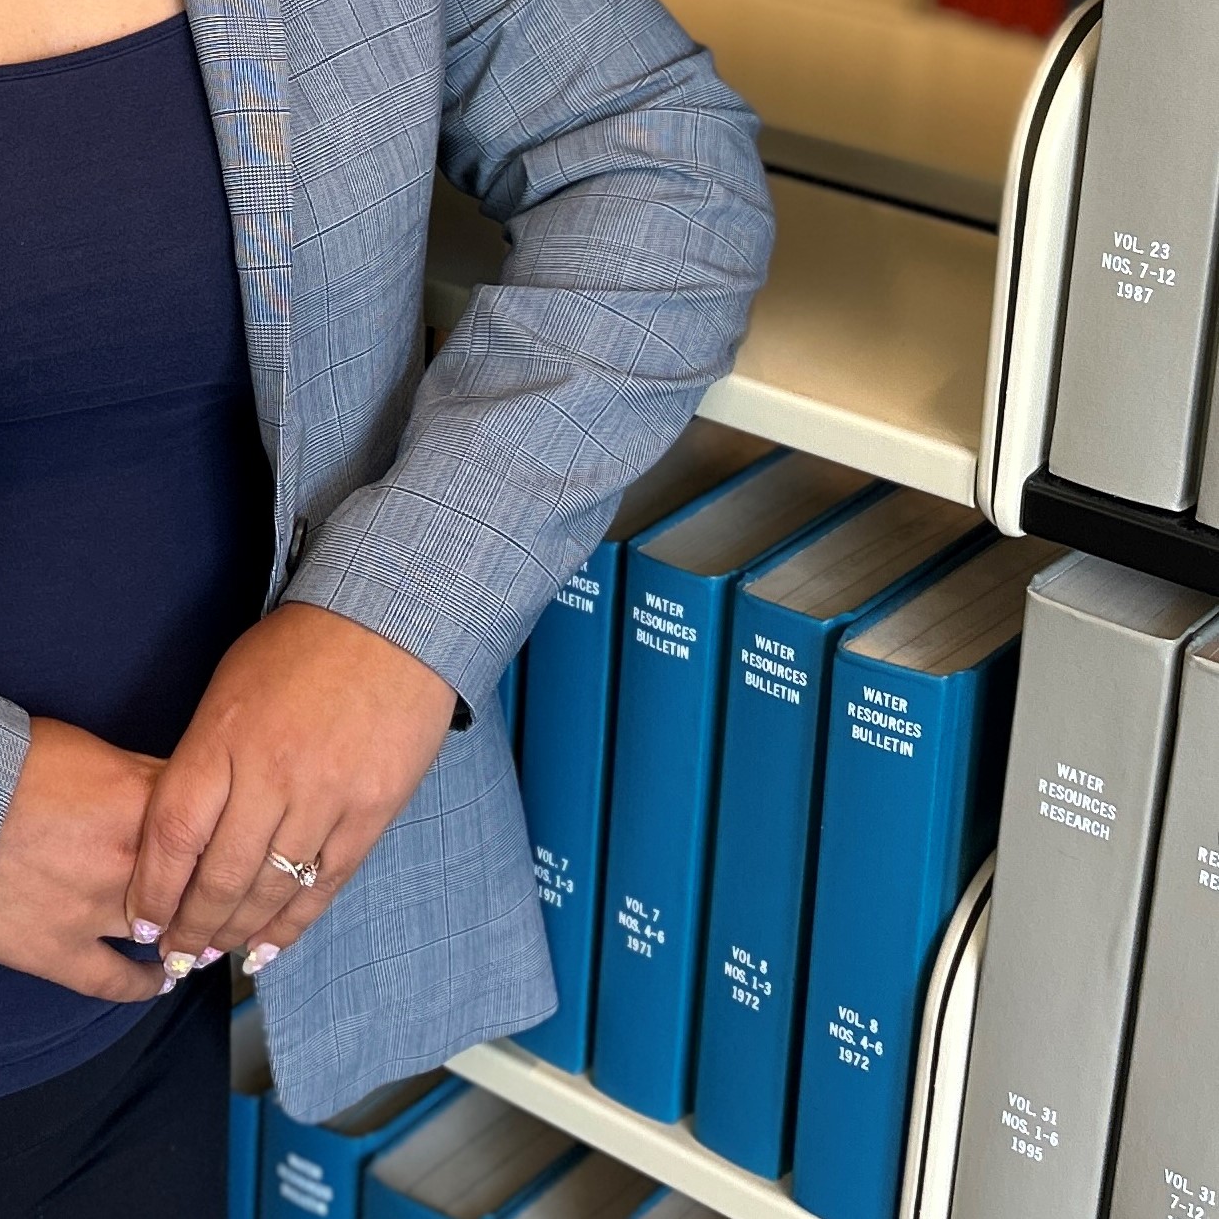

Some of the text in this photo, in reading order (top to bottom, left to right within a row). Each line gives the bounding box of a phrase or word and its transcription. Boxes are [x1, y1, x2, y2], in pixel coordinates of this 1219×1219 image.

[1150, 242, 1170, 260] 23
[1140, 263, 1176, 286] 7-12
[1117, 281, 1153, 303] 1987
[557, 592, 594, 614] LLETIN
[646, 592, 684, 618] WATER
[633, 607, 697, 642] RESOURCES
[636, 628, 689, 660] BULLETIN
[755, 633, 795, 661] WATER
[741, 649, 808, 687] RESOURCES
[745, 671, 800, 705] BULLETIN
[863, 685, 908, 714] WATER
[848, 702, 922, 739] RESOURCES
[852, 724, 914, 758] BULLETIN
[1057, 762, 1104, 793] WATER
[1038, 778, 1117, 821] RESOURCES
[1039, 801, 1110, 840] RESEARCH
[537, 846, 569, 871] VOL. 7
[538, 885, 562, 907] 1971
[556, 875, 574, 893] 1-3
[653, 908, 660, 922] 7
[627, 935, 652, 958] 1971
[644, 925, 664, 944] 4-6
[724, 962, 772, 996] NOS. 1-3
[760, 960, 768, 975] 8
[732, 985, 760, 1011] 1972
[830, 1022, 883, 1056] NOS. 4-6
[870, 1019, 878, 1034] 8
[838, 1046, 870, 1071] 1972
[1002, 1110, 1059, 1147] NOS. 1-6
[1041, 1107, 1057, 1125] 31
[1011, 1136, 1043, 1161] 1995
[1170, 1194, 1204, 1219] 7-12
[1199, 1186, 1217, 1206] 31
